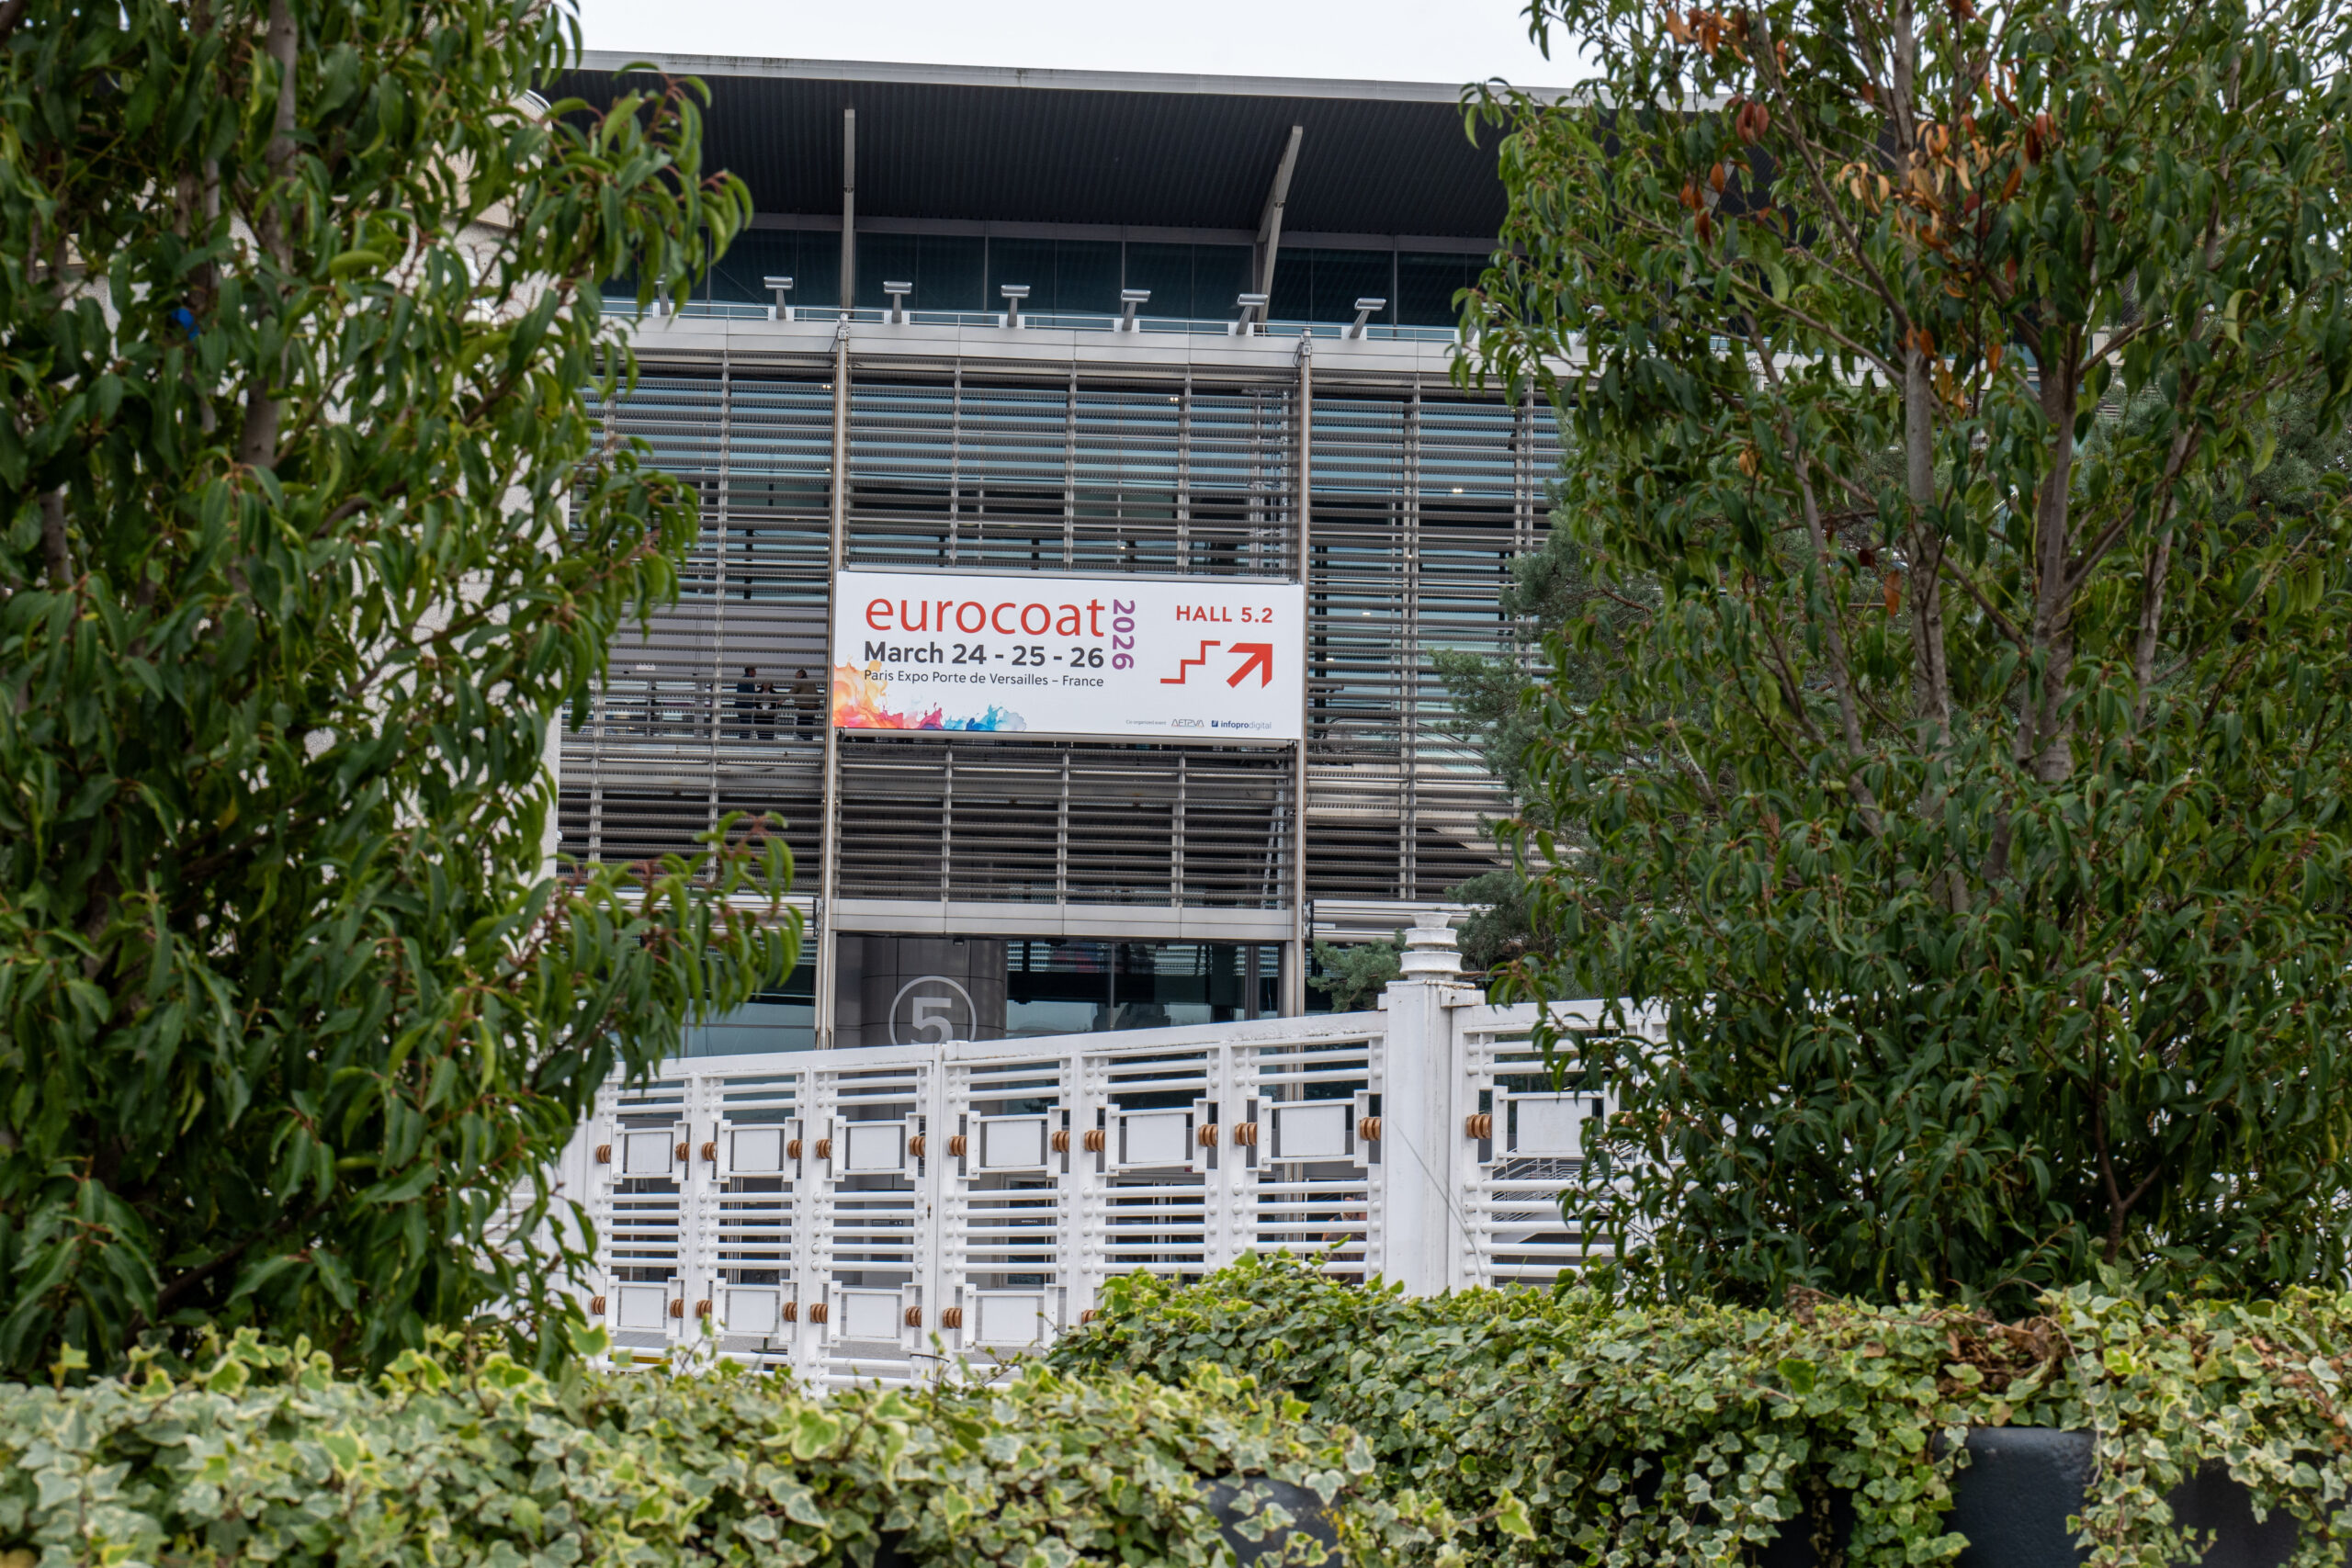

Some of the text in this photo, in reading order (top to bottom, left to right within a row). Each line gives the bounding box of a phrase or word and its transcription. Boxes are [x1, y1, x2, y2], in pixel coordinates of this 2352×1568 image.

[865, 598, 1105, 637] eurocoat
[1176, 605, 1273, 624] HALL 5.2
[1112, 598, 1136, 670] 2026
[865, 640, 944, 664] March
[951, 643, 988, 665] 24
[1011, 645, 1046, 667] 25
[1069, 647, 1104, 669] 26
[864, 669, 894, 682] Paris
[898, 670, 929, 684] Expo
[933, 671, 967, 683] Porte
[969, 671, 987, 684] de
[989, 672, 1049, 685] Versailles
[1062, 674, 1104, 687] France
[910, 998, 954, 1044] 5
